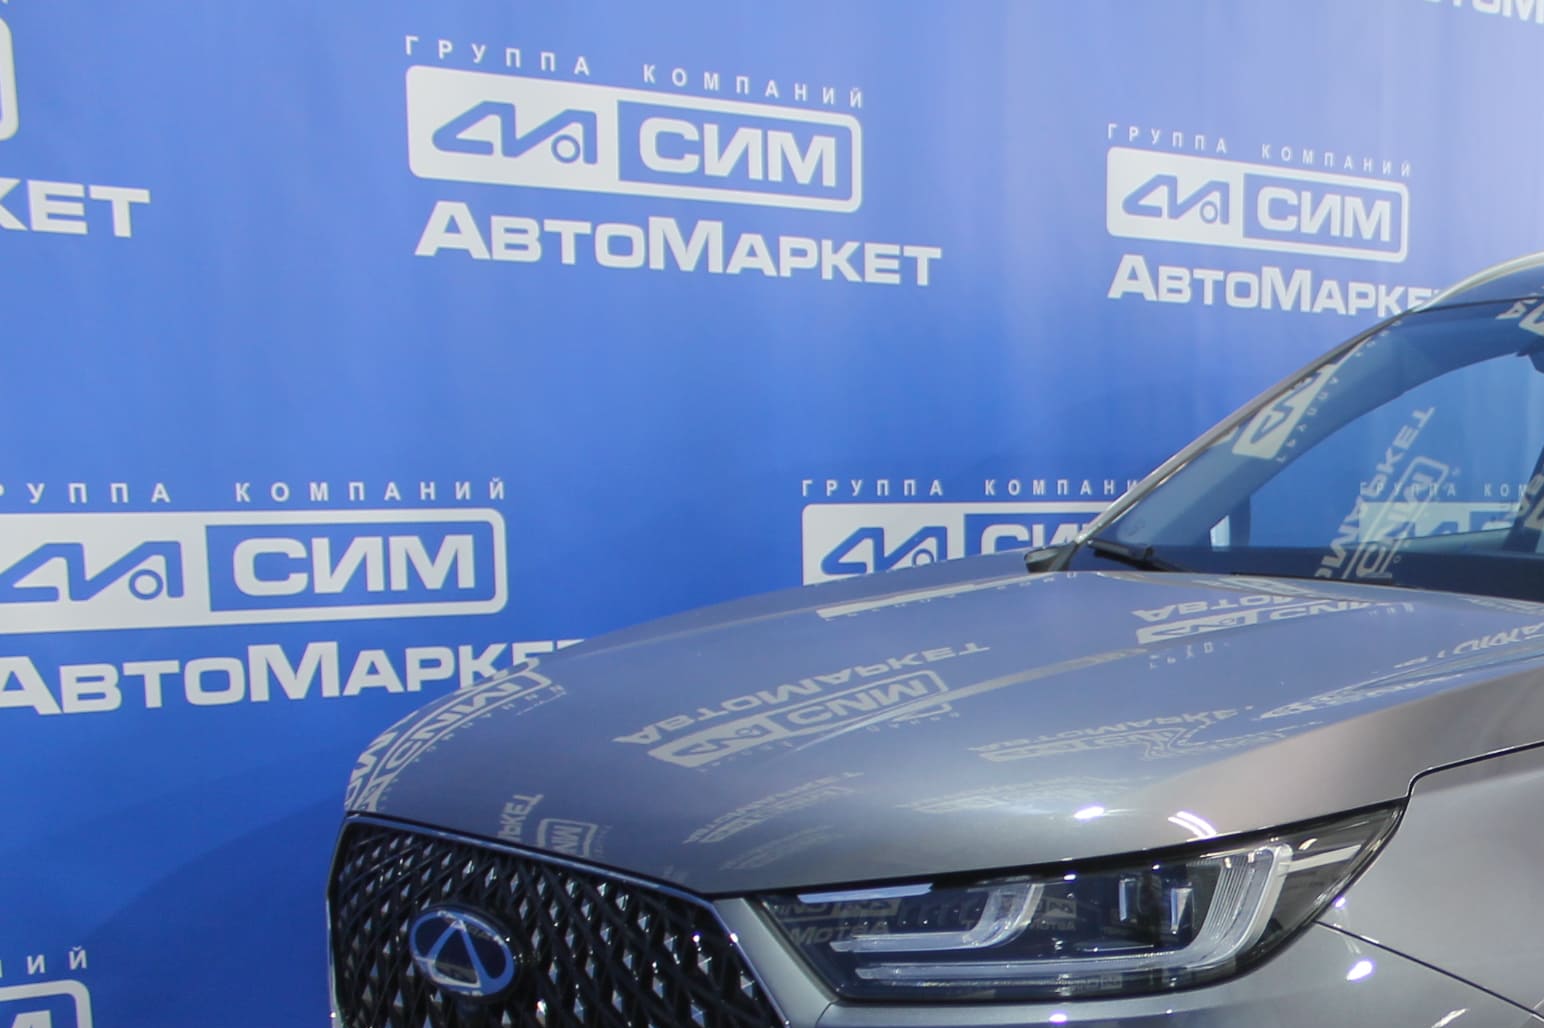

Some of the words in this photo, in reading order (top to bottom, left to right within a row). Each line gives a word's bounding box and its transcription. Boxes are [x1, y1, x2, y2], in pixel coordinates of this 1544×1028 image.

[405, 35, 590, 76] ГРУППА
[643, 64, 863, 108] КОМПАНИЙ
[639, 116, 837, 187] СИМ
[1107, 123, 1227, 153] ГРУППА
[1262, 144, 1411, 177] КОМПАНИЙ
[1257, 186, 1391, 242] СИМ
[1107, 254, 1440, 317] АВТОМАРКЕ
[0, 483, 170, 504] УППА
[235, 477, 505, 502] КОМПАНИЙ
[802, 480, 943, 496] ГРУППА
[233, 534, 475, 596] СИМ
